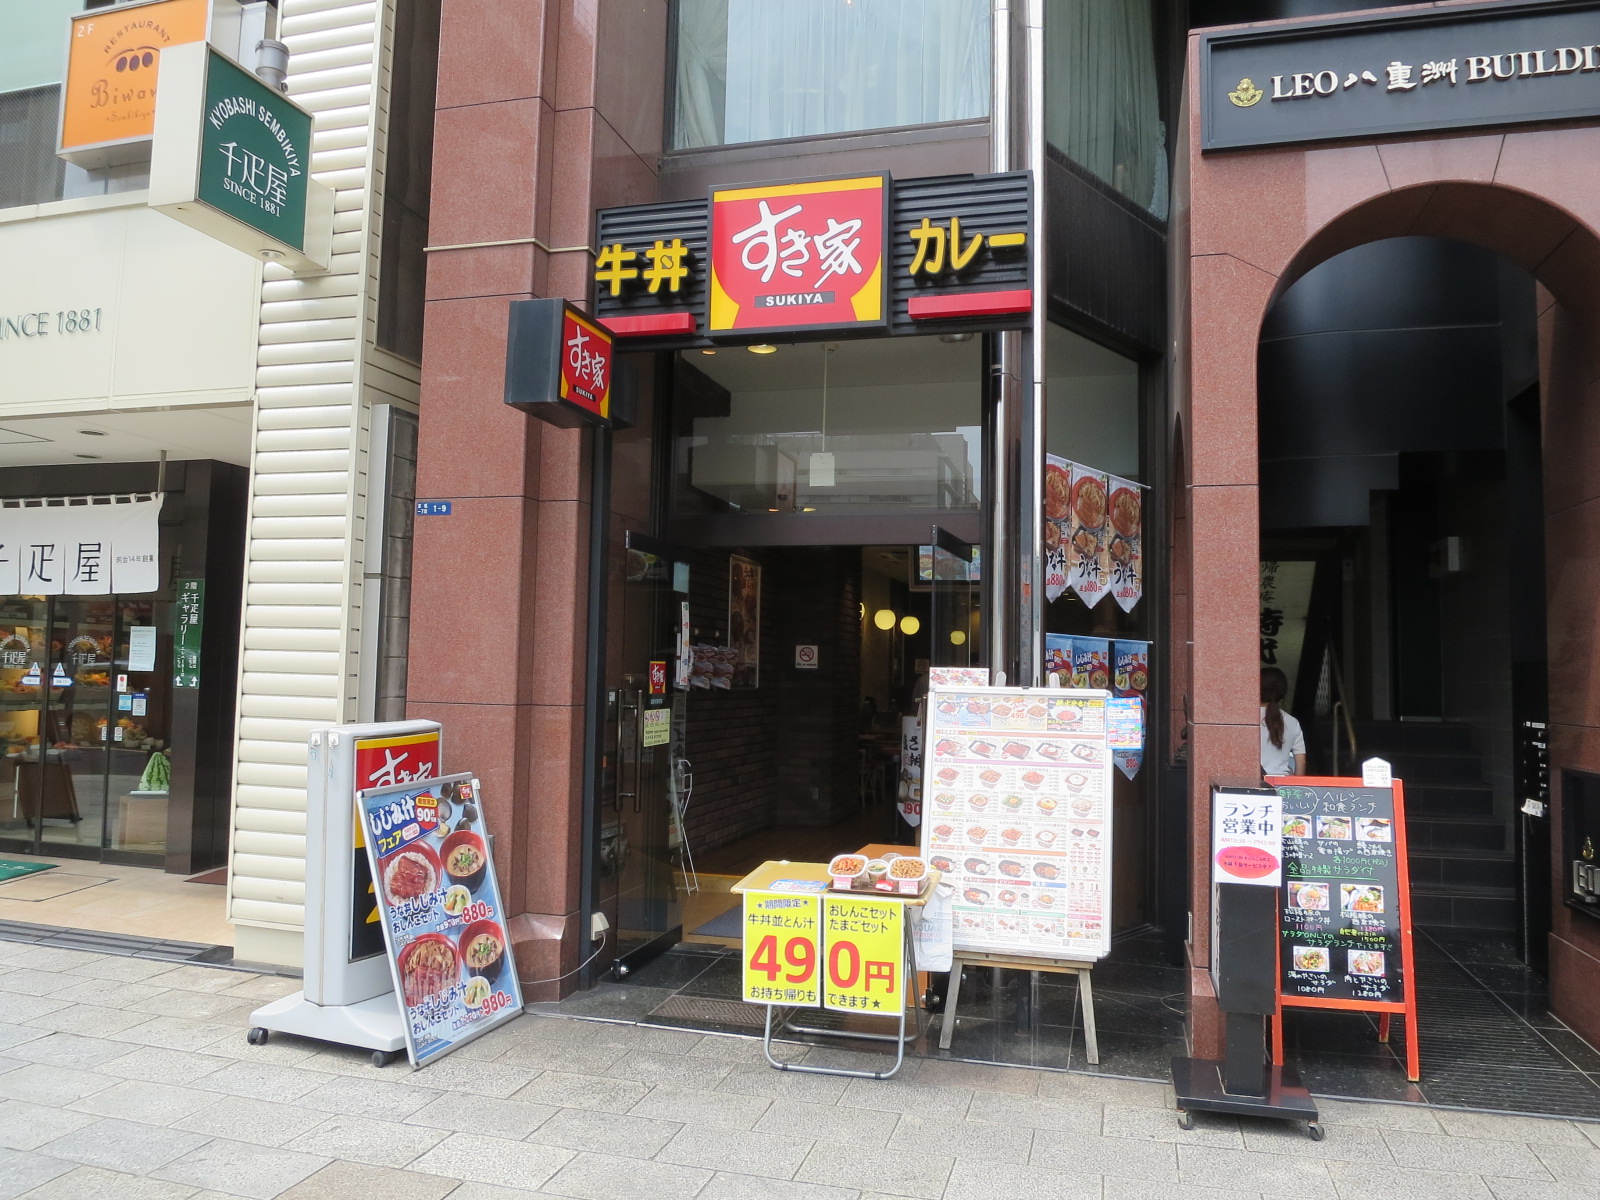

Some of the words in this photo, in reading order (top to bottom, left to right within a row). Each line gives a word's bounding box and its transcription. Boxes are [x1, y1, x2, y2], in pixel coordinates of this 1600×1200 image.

[78, 24, 94, 37] 2F
[104, 21, 171, 54] RESTAURANT
[1271, 70, 1338, 100] LEO
[1466, 44, 1600, 83] BUILDI
[209, 97, 255, 130] KYOBASHI
[258, 106, 301, 176] SEMBIKIYA
[219, 142, 287, 206] 千疋屋
[223, 177, 256, 205] SINCE
[260, 197, 280, 217] 1881
[732, 200, 862, 289] すき家
[909, 217, 1026, 276] カレー
[596, 239, 689, 296] 牛丼
[765, 293, 823, 307] SUKIYA
[56, 307, 102, 334] 1881
[568, 325, 606, 390] すき家
[575, 387, 594, 400] SUKIYA
[433, 504, 447, 513] 1-9
[1046, 549, 1066, 571] な牛
[185, 582, 197, 590] 2階
[181, 593, 190, 645] ギャラリー
[189, 593, 199, 624] 千疋屋
[2, 652, 26, 665] 千疋屋
[72, 653, 96, 665] 千疋屋
[1323, 792, 1374, 802] ヘルシー
[1323, 802, 1377, 814] 和食ランチ
[369, 795, 414, 835] しじみ汁
[1224, 803, 1274, 818] ランチ
[1223, 818, 1274, 836] 営業中
[378, 830, 401, 852] フェア
[390, 888, 447, 919] うな丼しじみ汁
[463, 901, 493, 923] 880円
[765, 899, 801, 909] 期間限定
[830, 905, 897, 920] おしんこセット
[393, 909, 439, 933] おしんこセット
[748, 913, 815, 929] 牛丼並とん汁
[829, 919, 888, 933] たまごセット
[1296, 923, 1323, 931] 1100円
[1282, 930, 1334, 939] サラダONLYの
[750, 935, 815, 983] 49
[829, 940, 894, 993] 0円
[410, 981, 466, 1020] うな牛しじみ汁
[482, 991, 512, 1015] 980円
[750, 987, 816, 1001] お持ち帰りも
[1352, 990, 1382, 998] 1280円
[413, 1005, 459, 1034] おしんこセット
